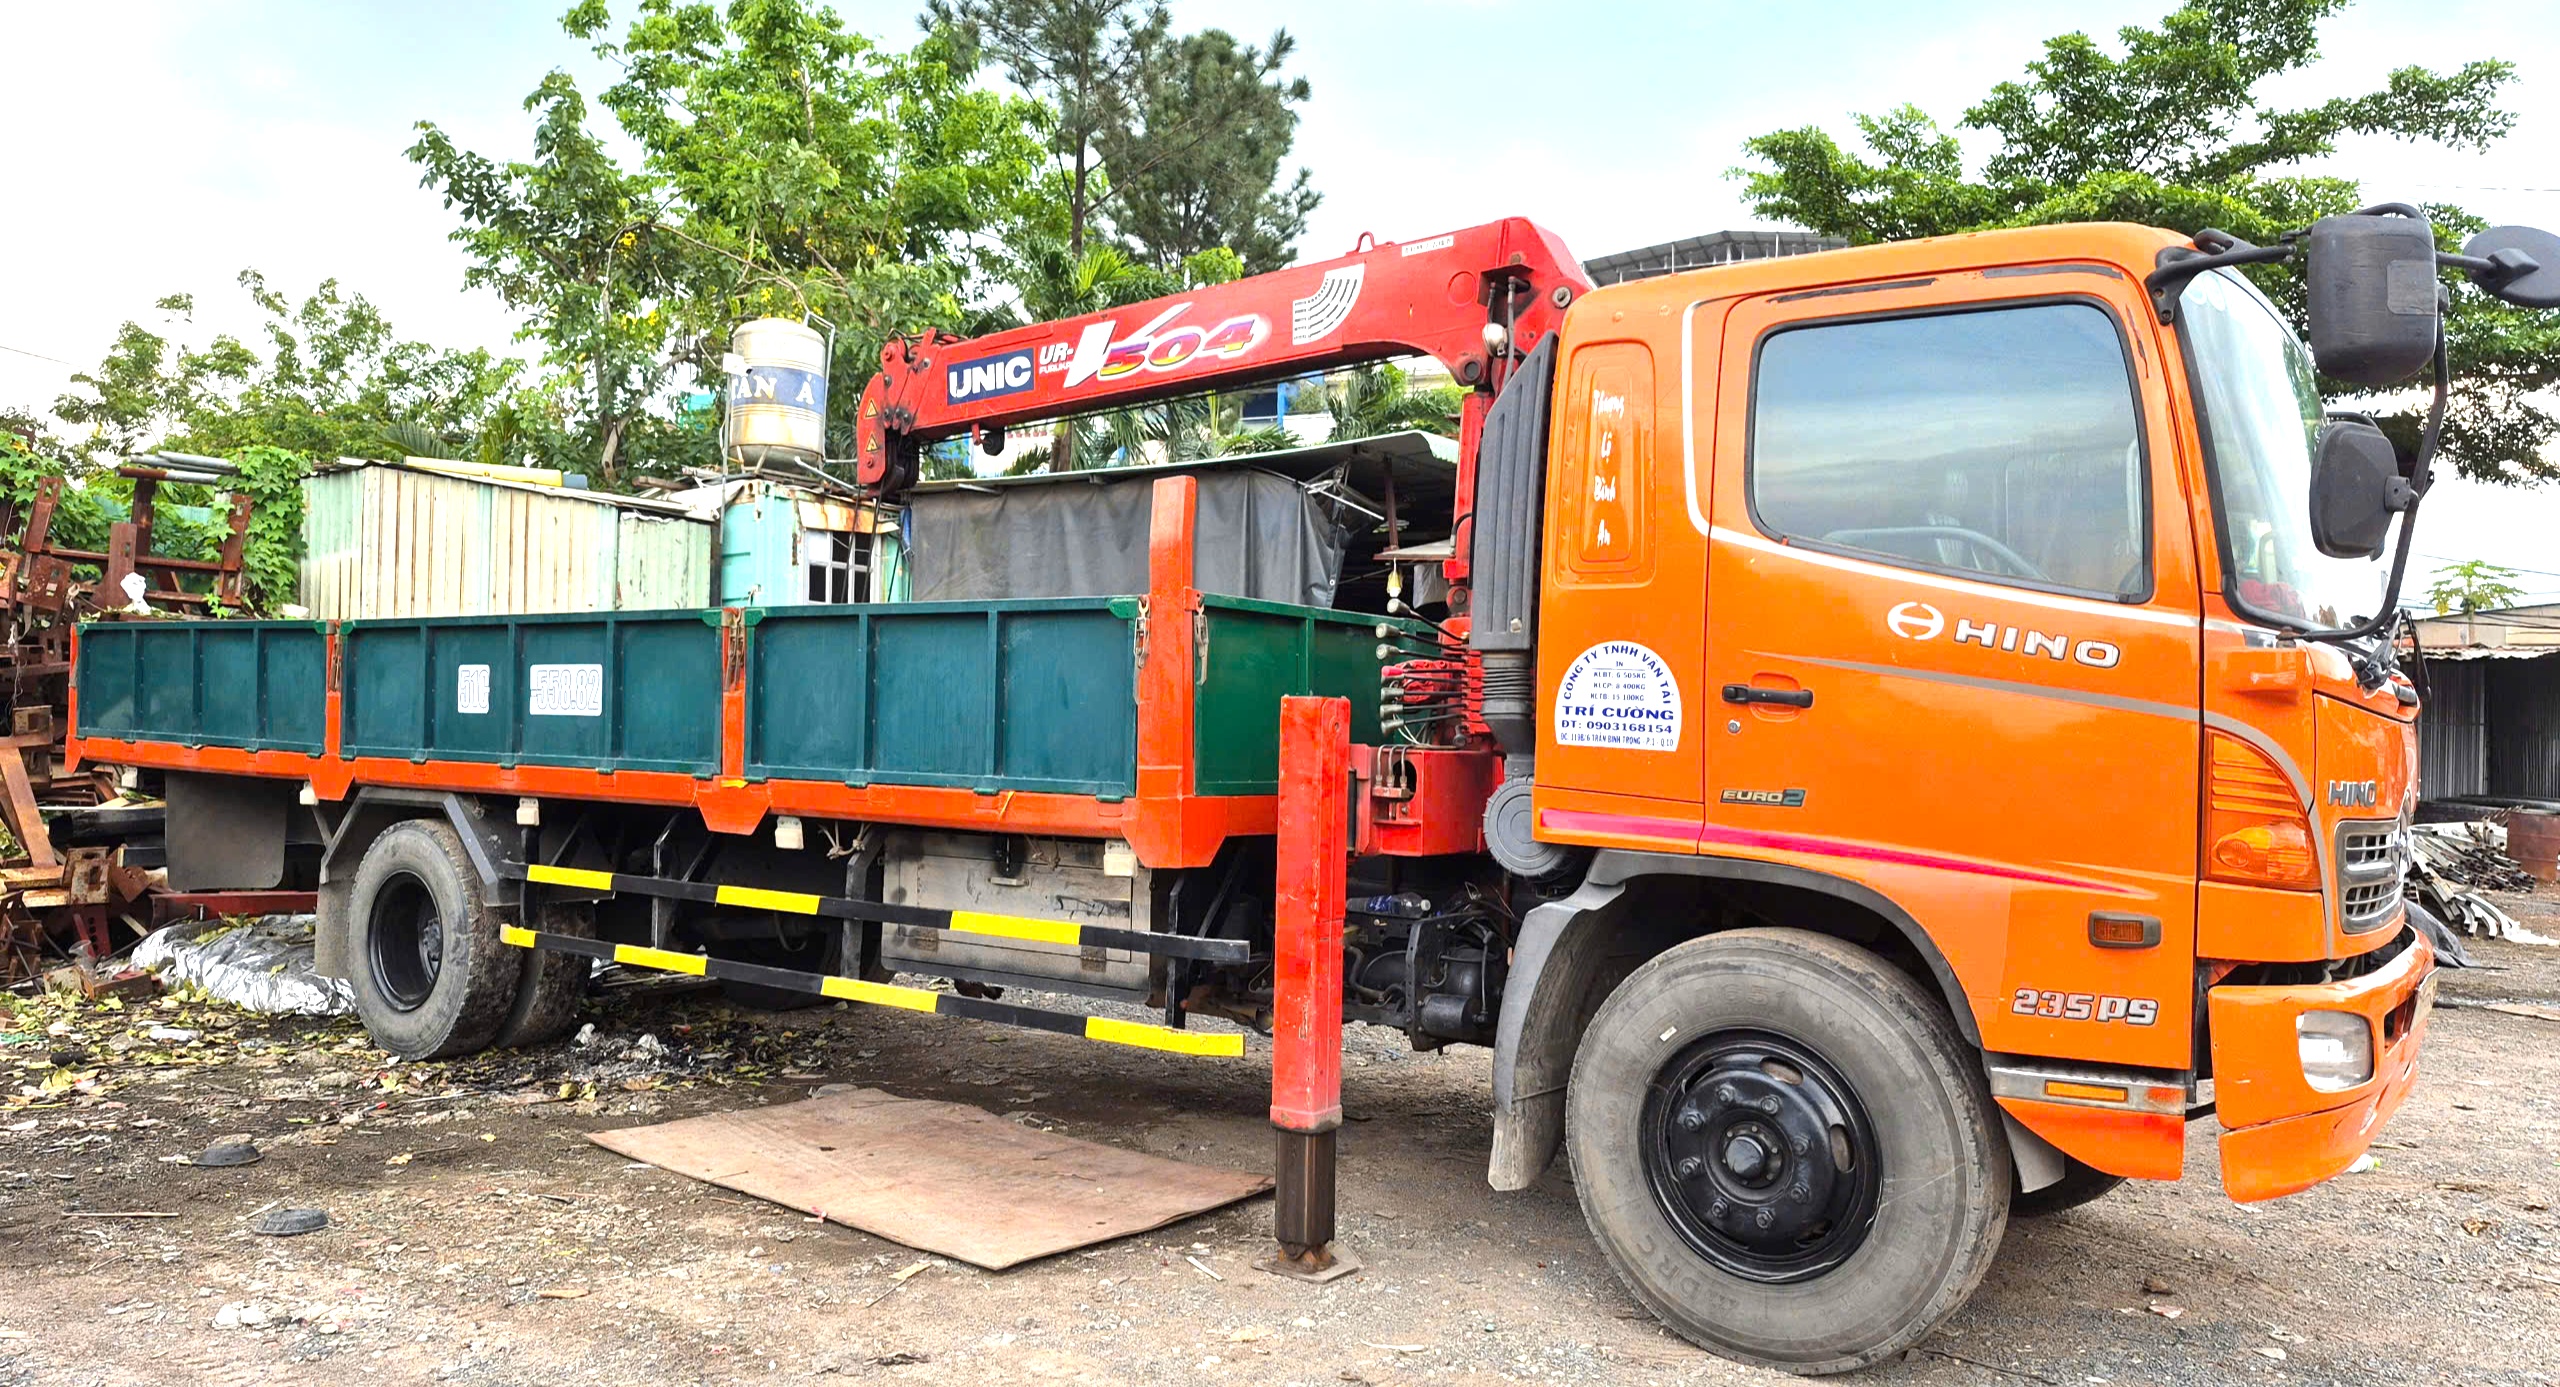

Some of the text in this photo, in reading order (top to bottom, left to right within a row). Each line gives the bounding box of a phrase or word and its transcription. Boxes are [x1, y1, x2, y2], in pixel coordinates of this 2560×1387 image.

[949, 355, 1032, 398] UNIC
[1597, 519, 1611, 548] An
[1954, 618, 2121, 669] HINO
[1563, 664, 1584, 700] CÔNG
[1583, 650, 1597, 664] TY
[1603, 645, 1639, 657] TNHH
[1660, 680, 1675, 704] TẢI
[1561, 719, 1673, 734] ĐT: 0903168154
[1562, 704, 1674, 721] TRÍ CƯỜNG
[2327, 780, 2377, 808] HINO
[2012, 988, 2159, 1026] 235 PS
